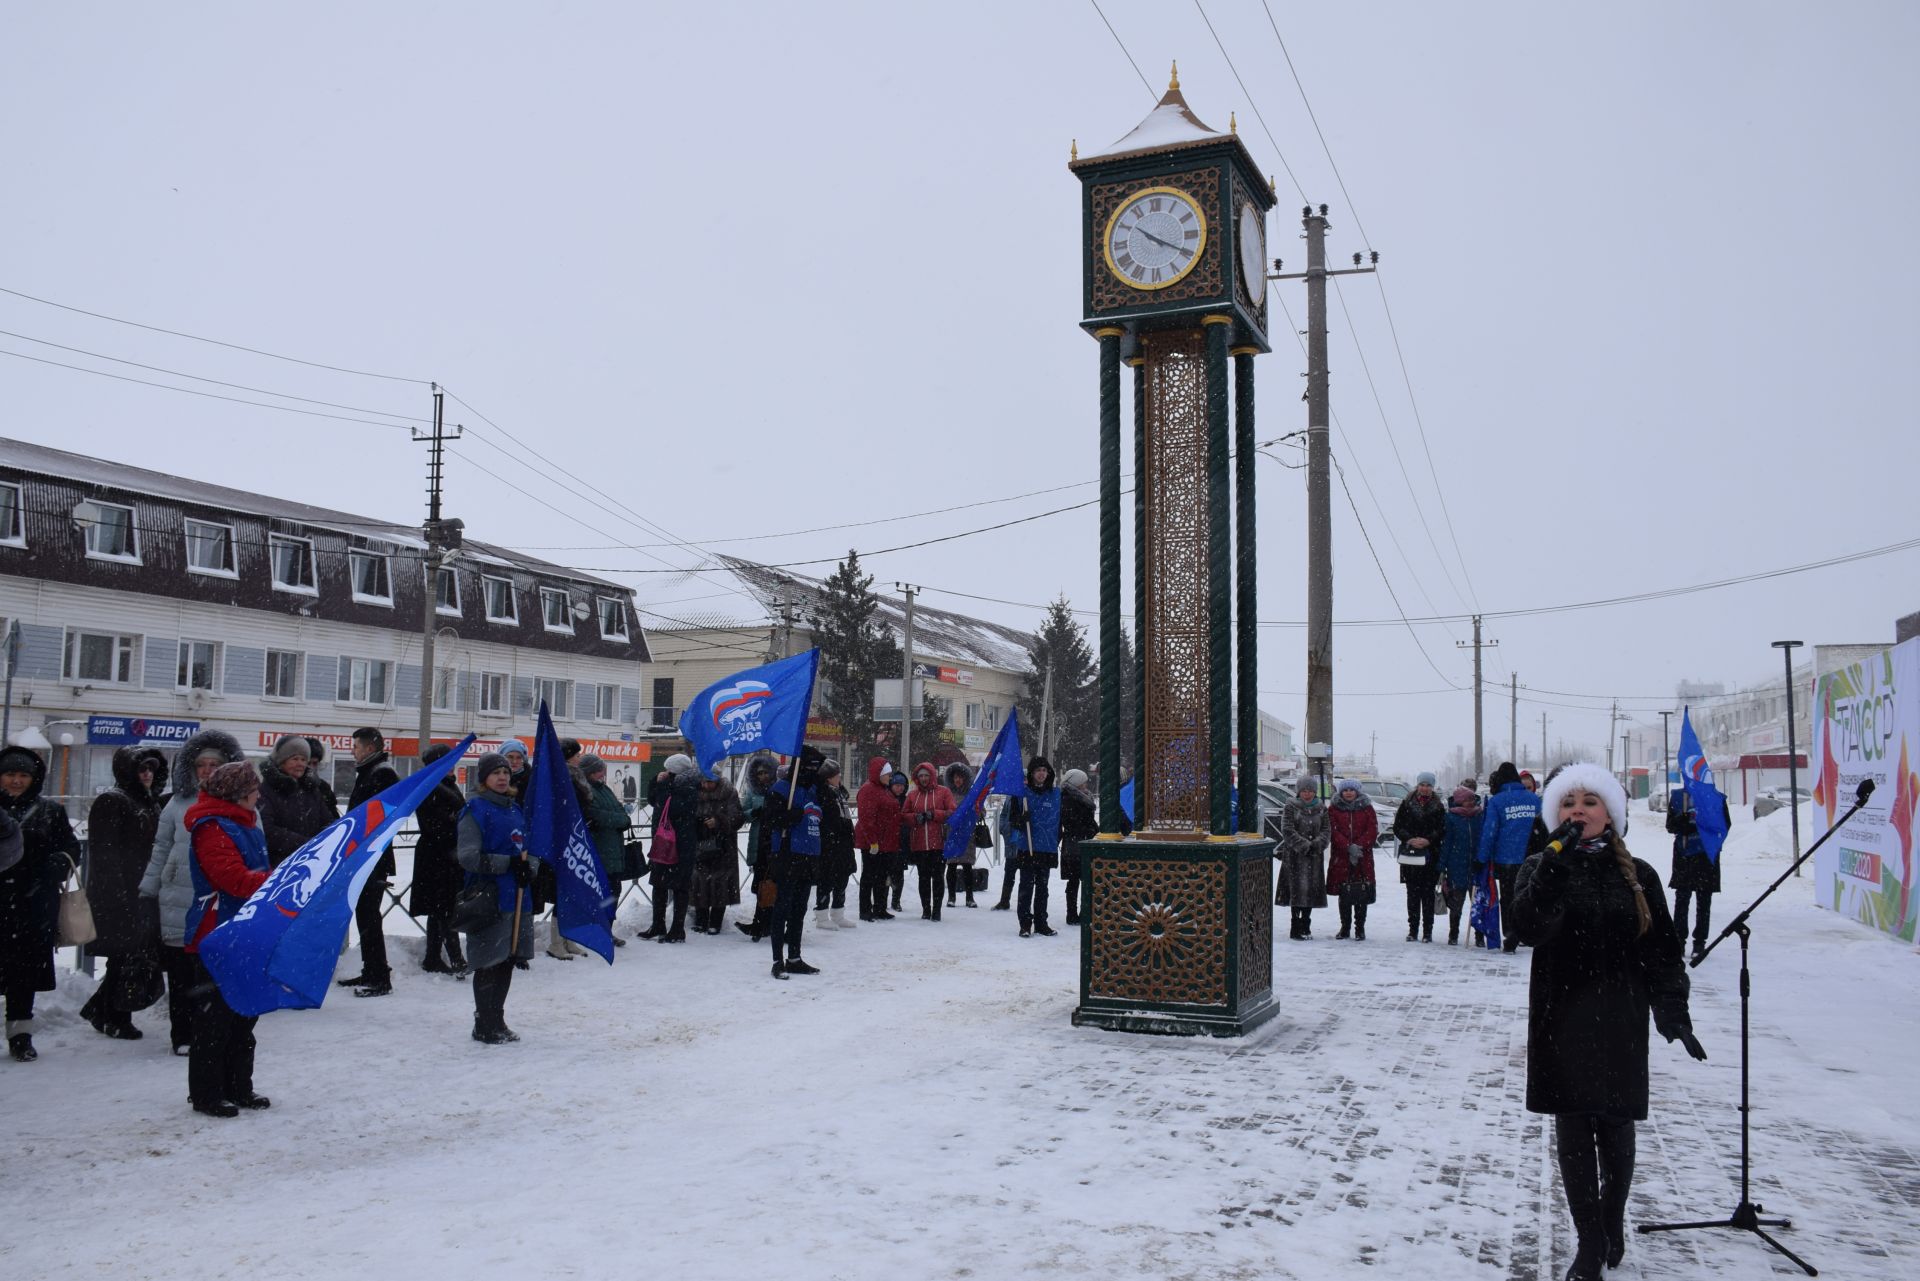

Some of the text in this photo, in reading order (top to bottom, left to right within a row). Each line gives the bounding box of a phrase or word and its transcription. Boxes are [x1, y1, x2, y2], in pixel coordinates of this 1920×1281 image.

[93, 726, 125, 736] АПТЕКА
[1505, 805, 1536, 814] ЕДИНАЯ
[1506, 811, 1536, 820] РОССИЯ
